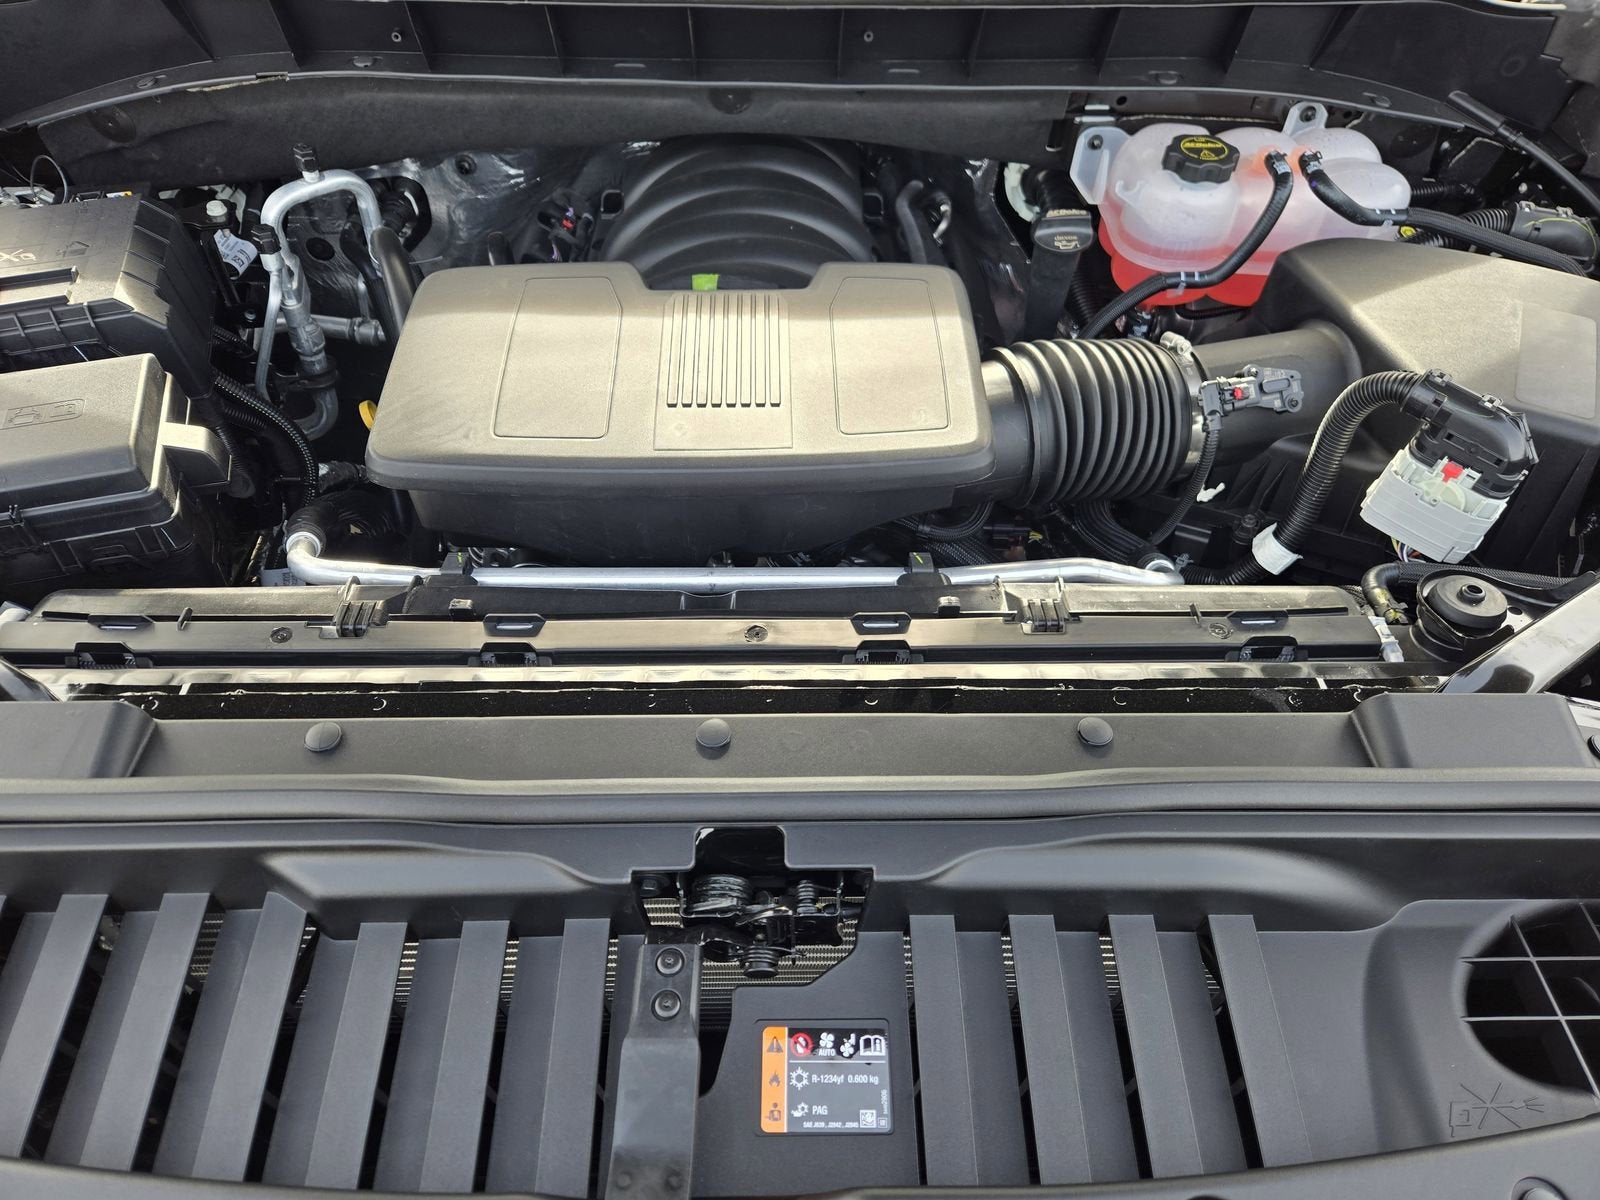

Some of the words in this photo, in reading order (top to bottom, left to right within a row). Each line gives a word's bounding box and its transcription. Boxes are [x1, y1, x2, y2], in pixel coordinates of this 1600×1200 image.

[1046, 208, 1088, 218] ACDelco
[818, 1048, 836, 1057] AUTO
[811, 1074, 845, 1085] R-1234yf
[847, 1074, 868, 1083] 0.600
[869, 1074, 879, 1086] kg
[812, 1105, 829, 1115] PAG
